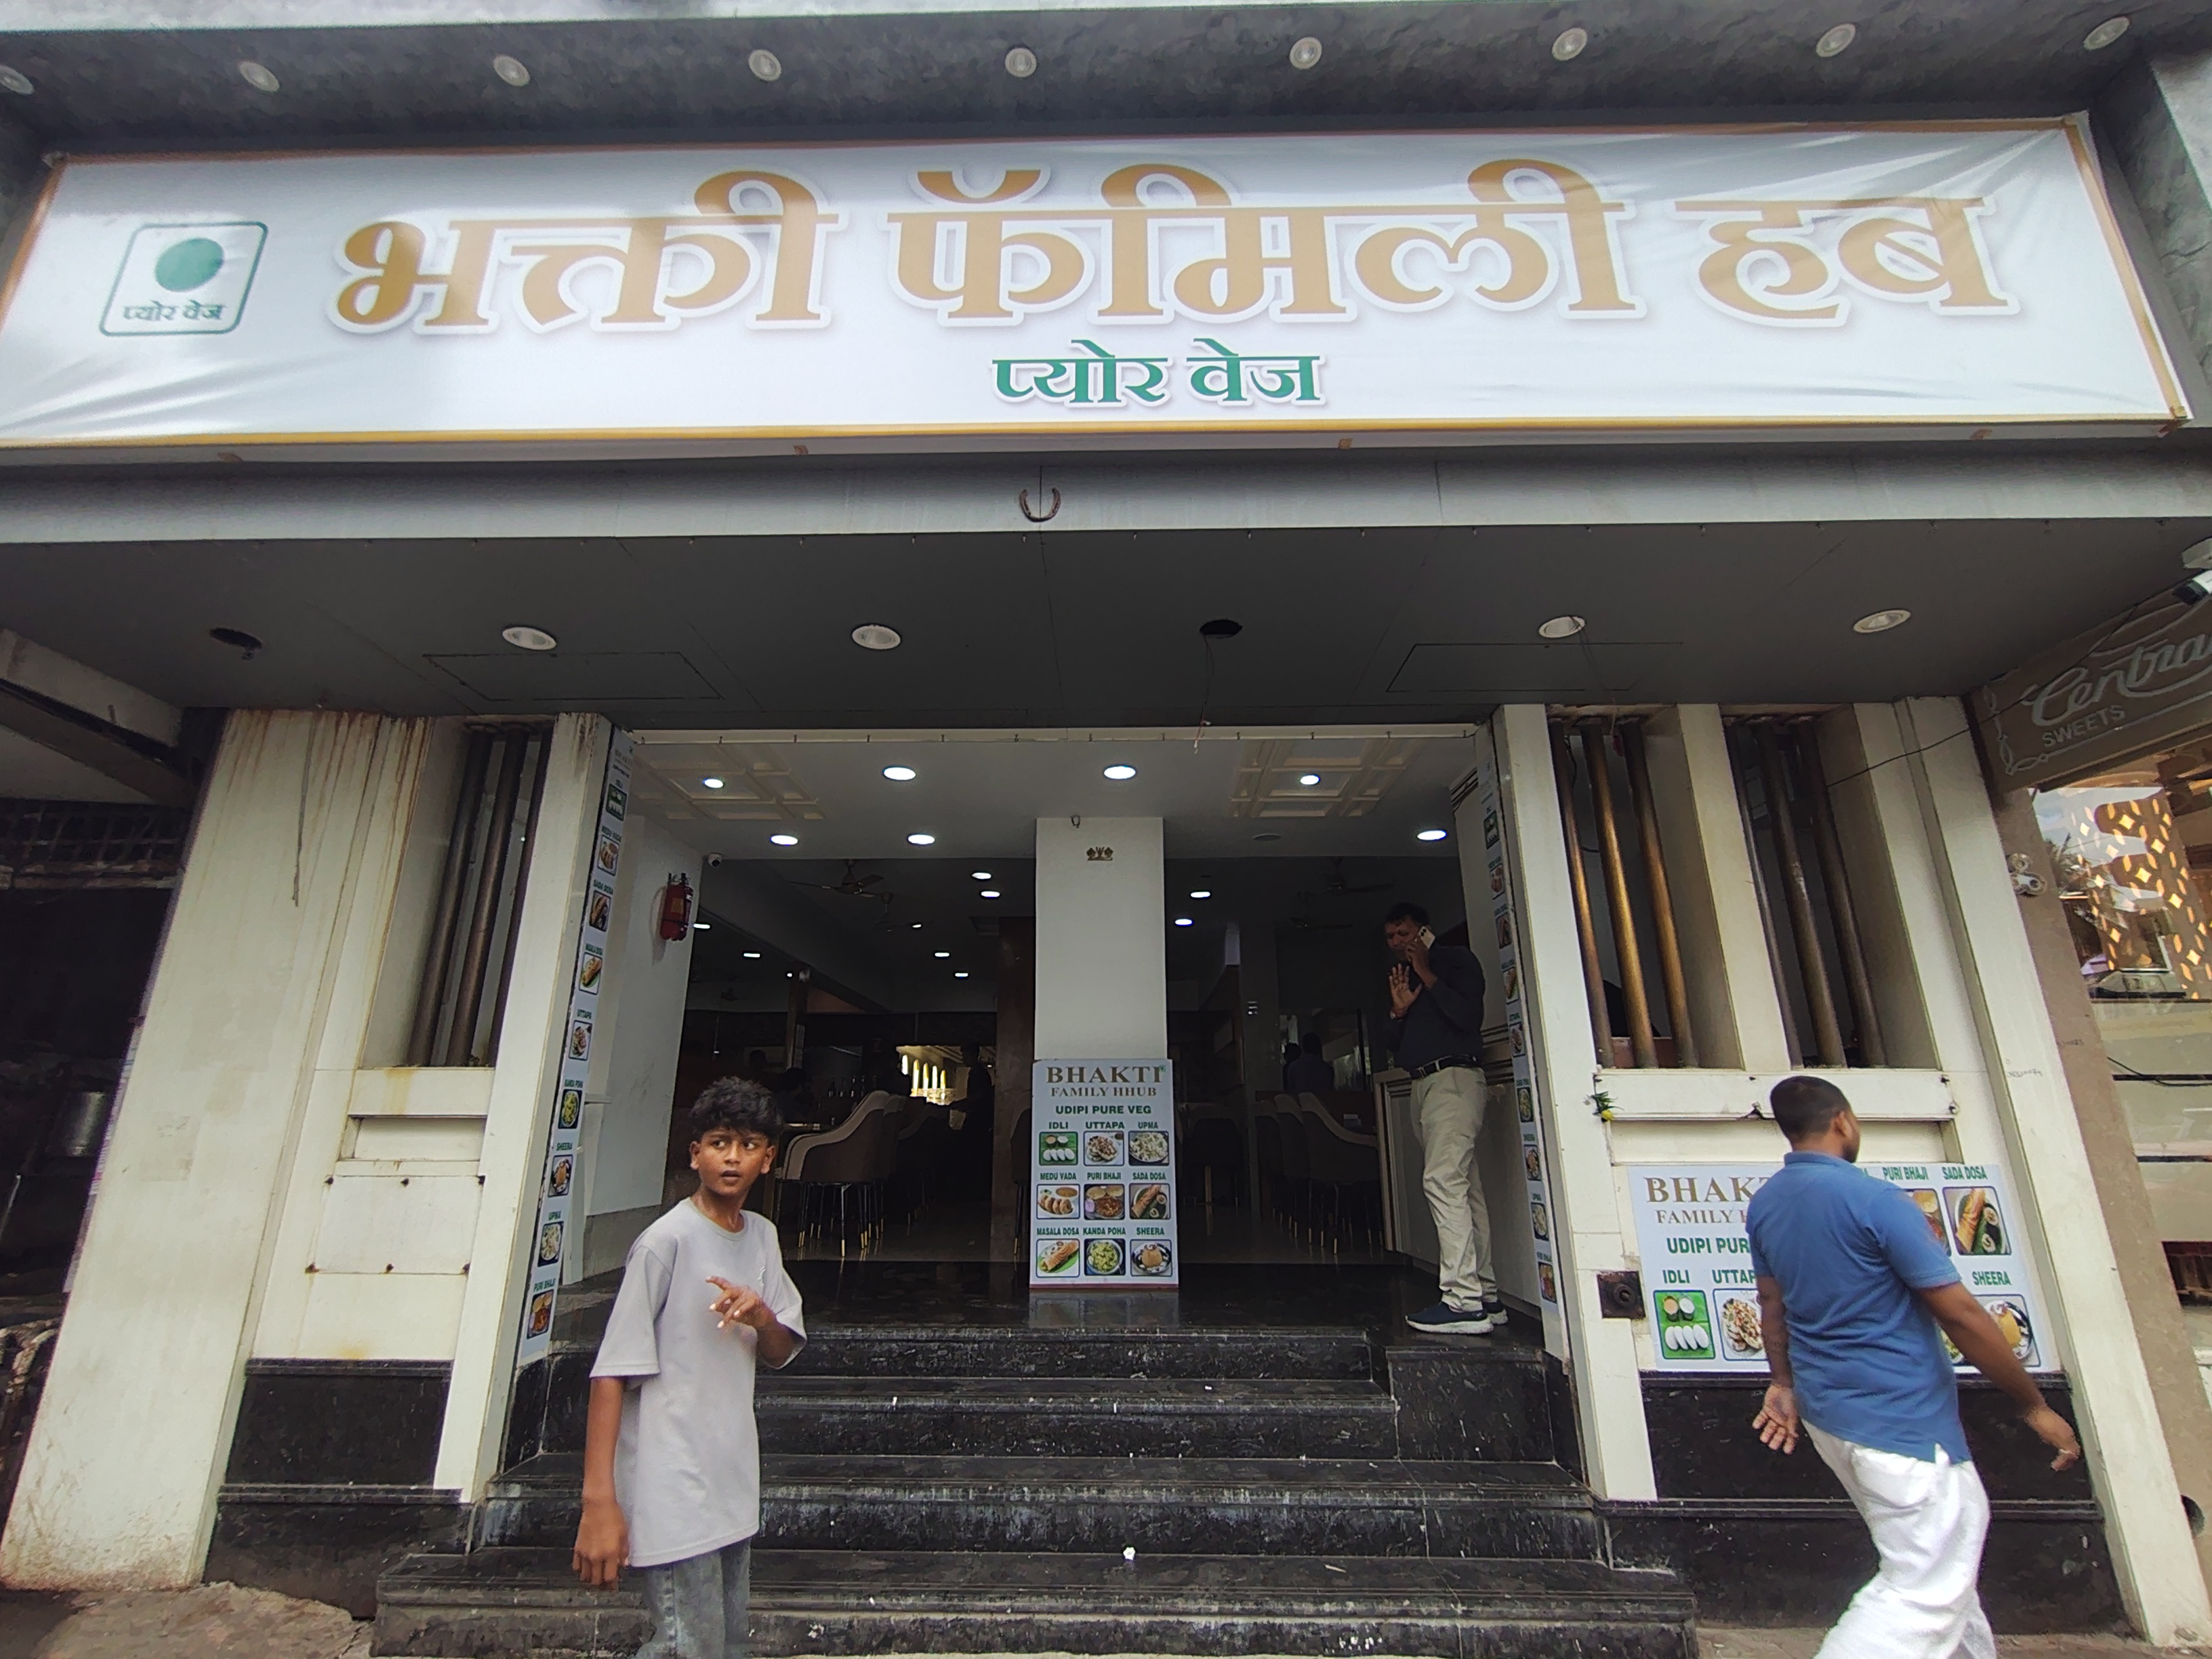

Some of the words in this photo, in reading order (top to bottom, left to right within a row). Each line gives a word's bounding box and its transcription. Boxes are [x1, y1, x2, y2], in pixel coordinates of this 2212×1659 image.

[886, 158, 1636, 319] फॅमिली
[1675, 196, 2008, 319] हब
[123, 299, 178, 321] प्योर
[182, 299, 227, 321] वेज
[992, 338, 1169, 403] प्योर
[1186, 337, 1322, 402] वेज
[2020, 632, 2212, 726] Centra
[2042, 705, 2126, 747] SWEETS
[1046, 1066, 1162, 1084] BHAKTI
[1051, 1087, 1109, 1097] FAMILY
[1113, 1087, 1157, 1097] HHUB
[1055, 1105, 1088, 1114] UDIPI
[1092, 1105, 1124, 1114] PURE
[1128, 1105, 1151, 1114] VEG
[1040, 1172, 1059, 1181] MEDU
[1059, 1172, 1077, 1181] VADA
[1132, 1172, 1149, 1180] SADA
[1149, 1172, 1166, 1180] DOSA
[1882, 1166, 1904, 1181] PURI
[1904, 1166, 1929, 1181] BHAJI
[1942, 1166, 1965, 1181] SADA
[1965, 1165, 1988, 1180] DOSA
[1643, 1176, 1771, 1203] BHAK
[1654, 1209, 1733, 1224] FAMILY
[1037, 1227, 1061, 1235] MASALA
[1136, 1227, 1165, 1235] SHEERA
[1666, 1237, 1712, 1254] UDIPI
[1715, 1237, 1750, 1254] PUR
[1662, 1269, 1690, 1284] IDLI
[1712, 1269, 1757, 1284] UTTAP
[1972, 1271, 2013, 1286] SHEERA
